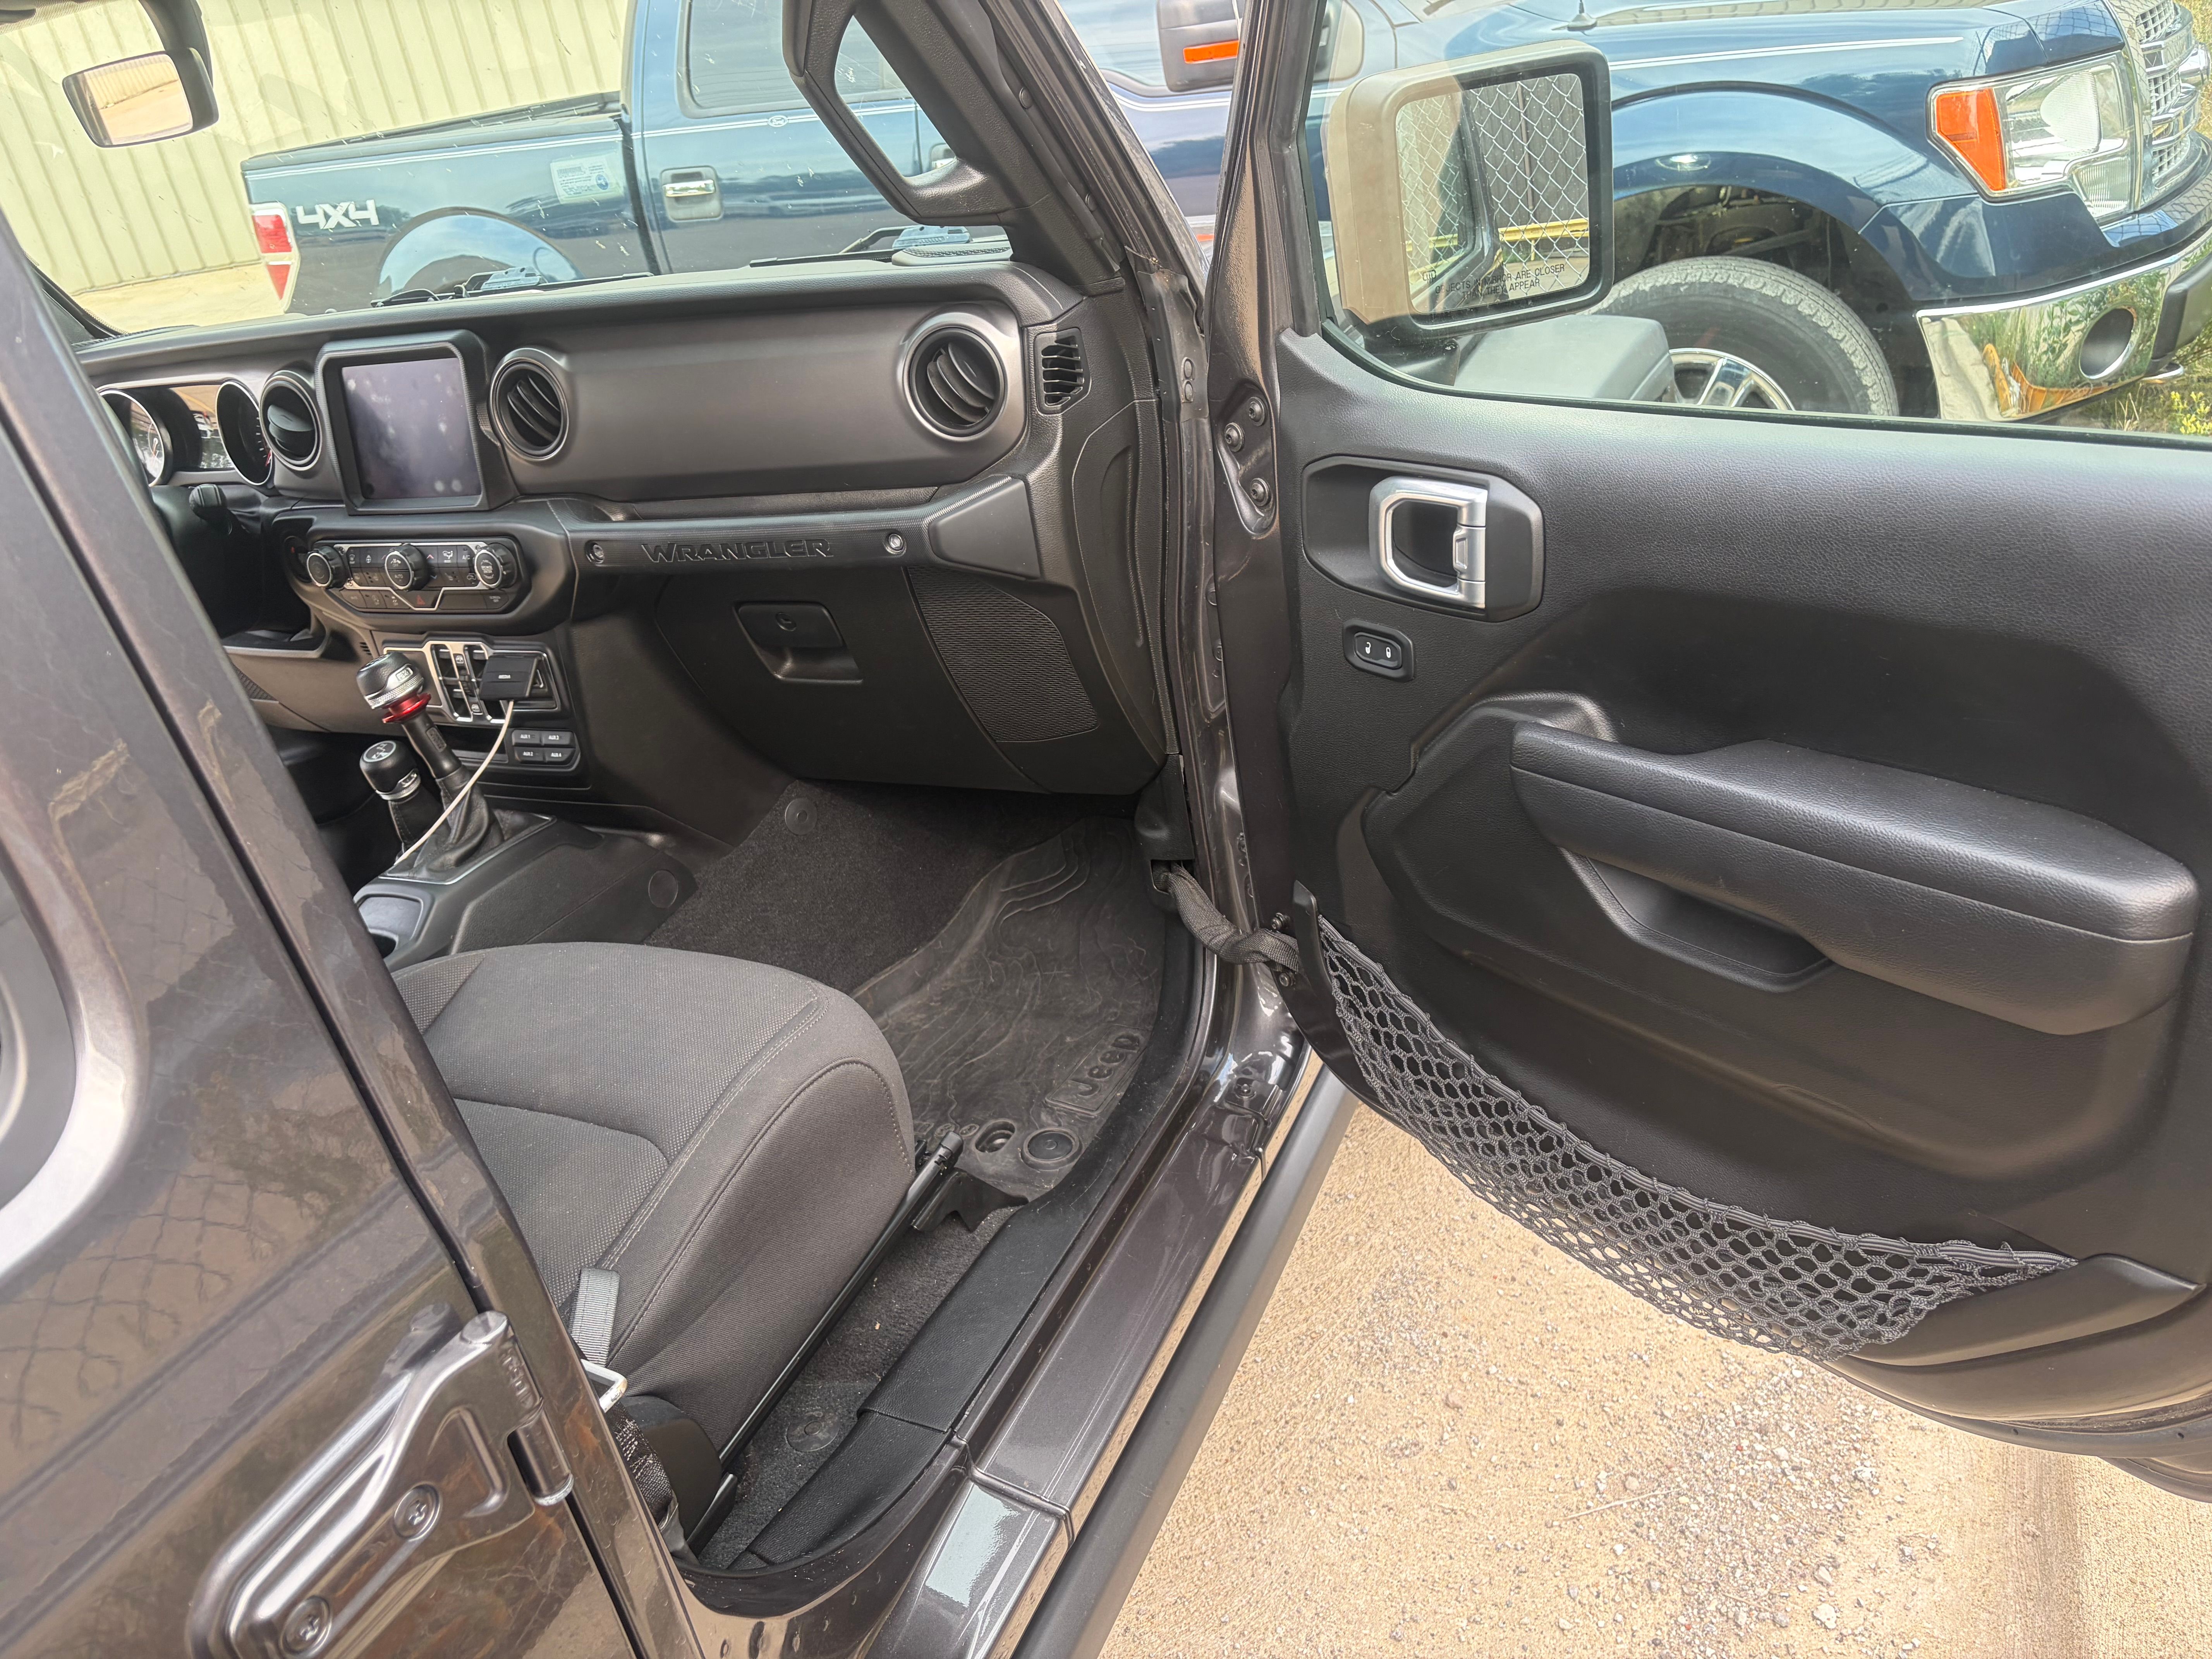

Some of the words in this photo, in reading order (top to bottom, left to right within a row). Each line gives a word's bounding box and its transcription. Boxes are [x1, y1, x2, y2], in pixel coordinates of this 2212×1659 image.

[296, 199, 379, 229] 4X4
[1435, 280, 1471, 294] OBJECTS
[1474, 278, 1481, 287] IN
[1484, 273, 1512, 285] MIRROR
[1516, 270, 1531, 280] ARE
[1535, 264, 1565, 276] CLOSER
[1462, 289, 1482, 299] THAN
[1486, 284, 1505, 295] THEY
[1509, 278, 1540, 292] APPEAR
[641, 539, 834, 563] WRANGLER
[1068, 1032, 1141, 1097] Jeep
